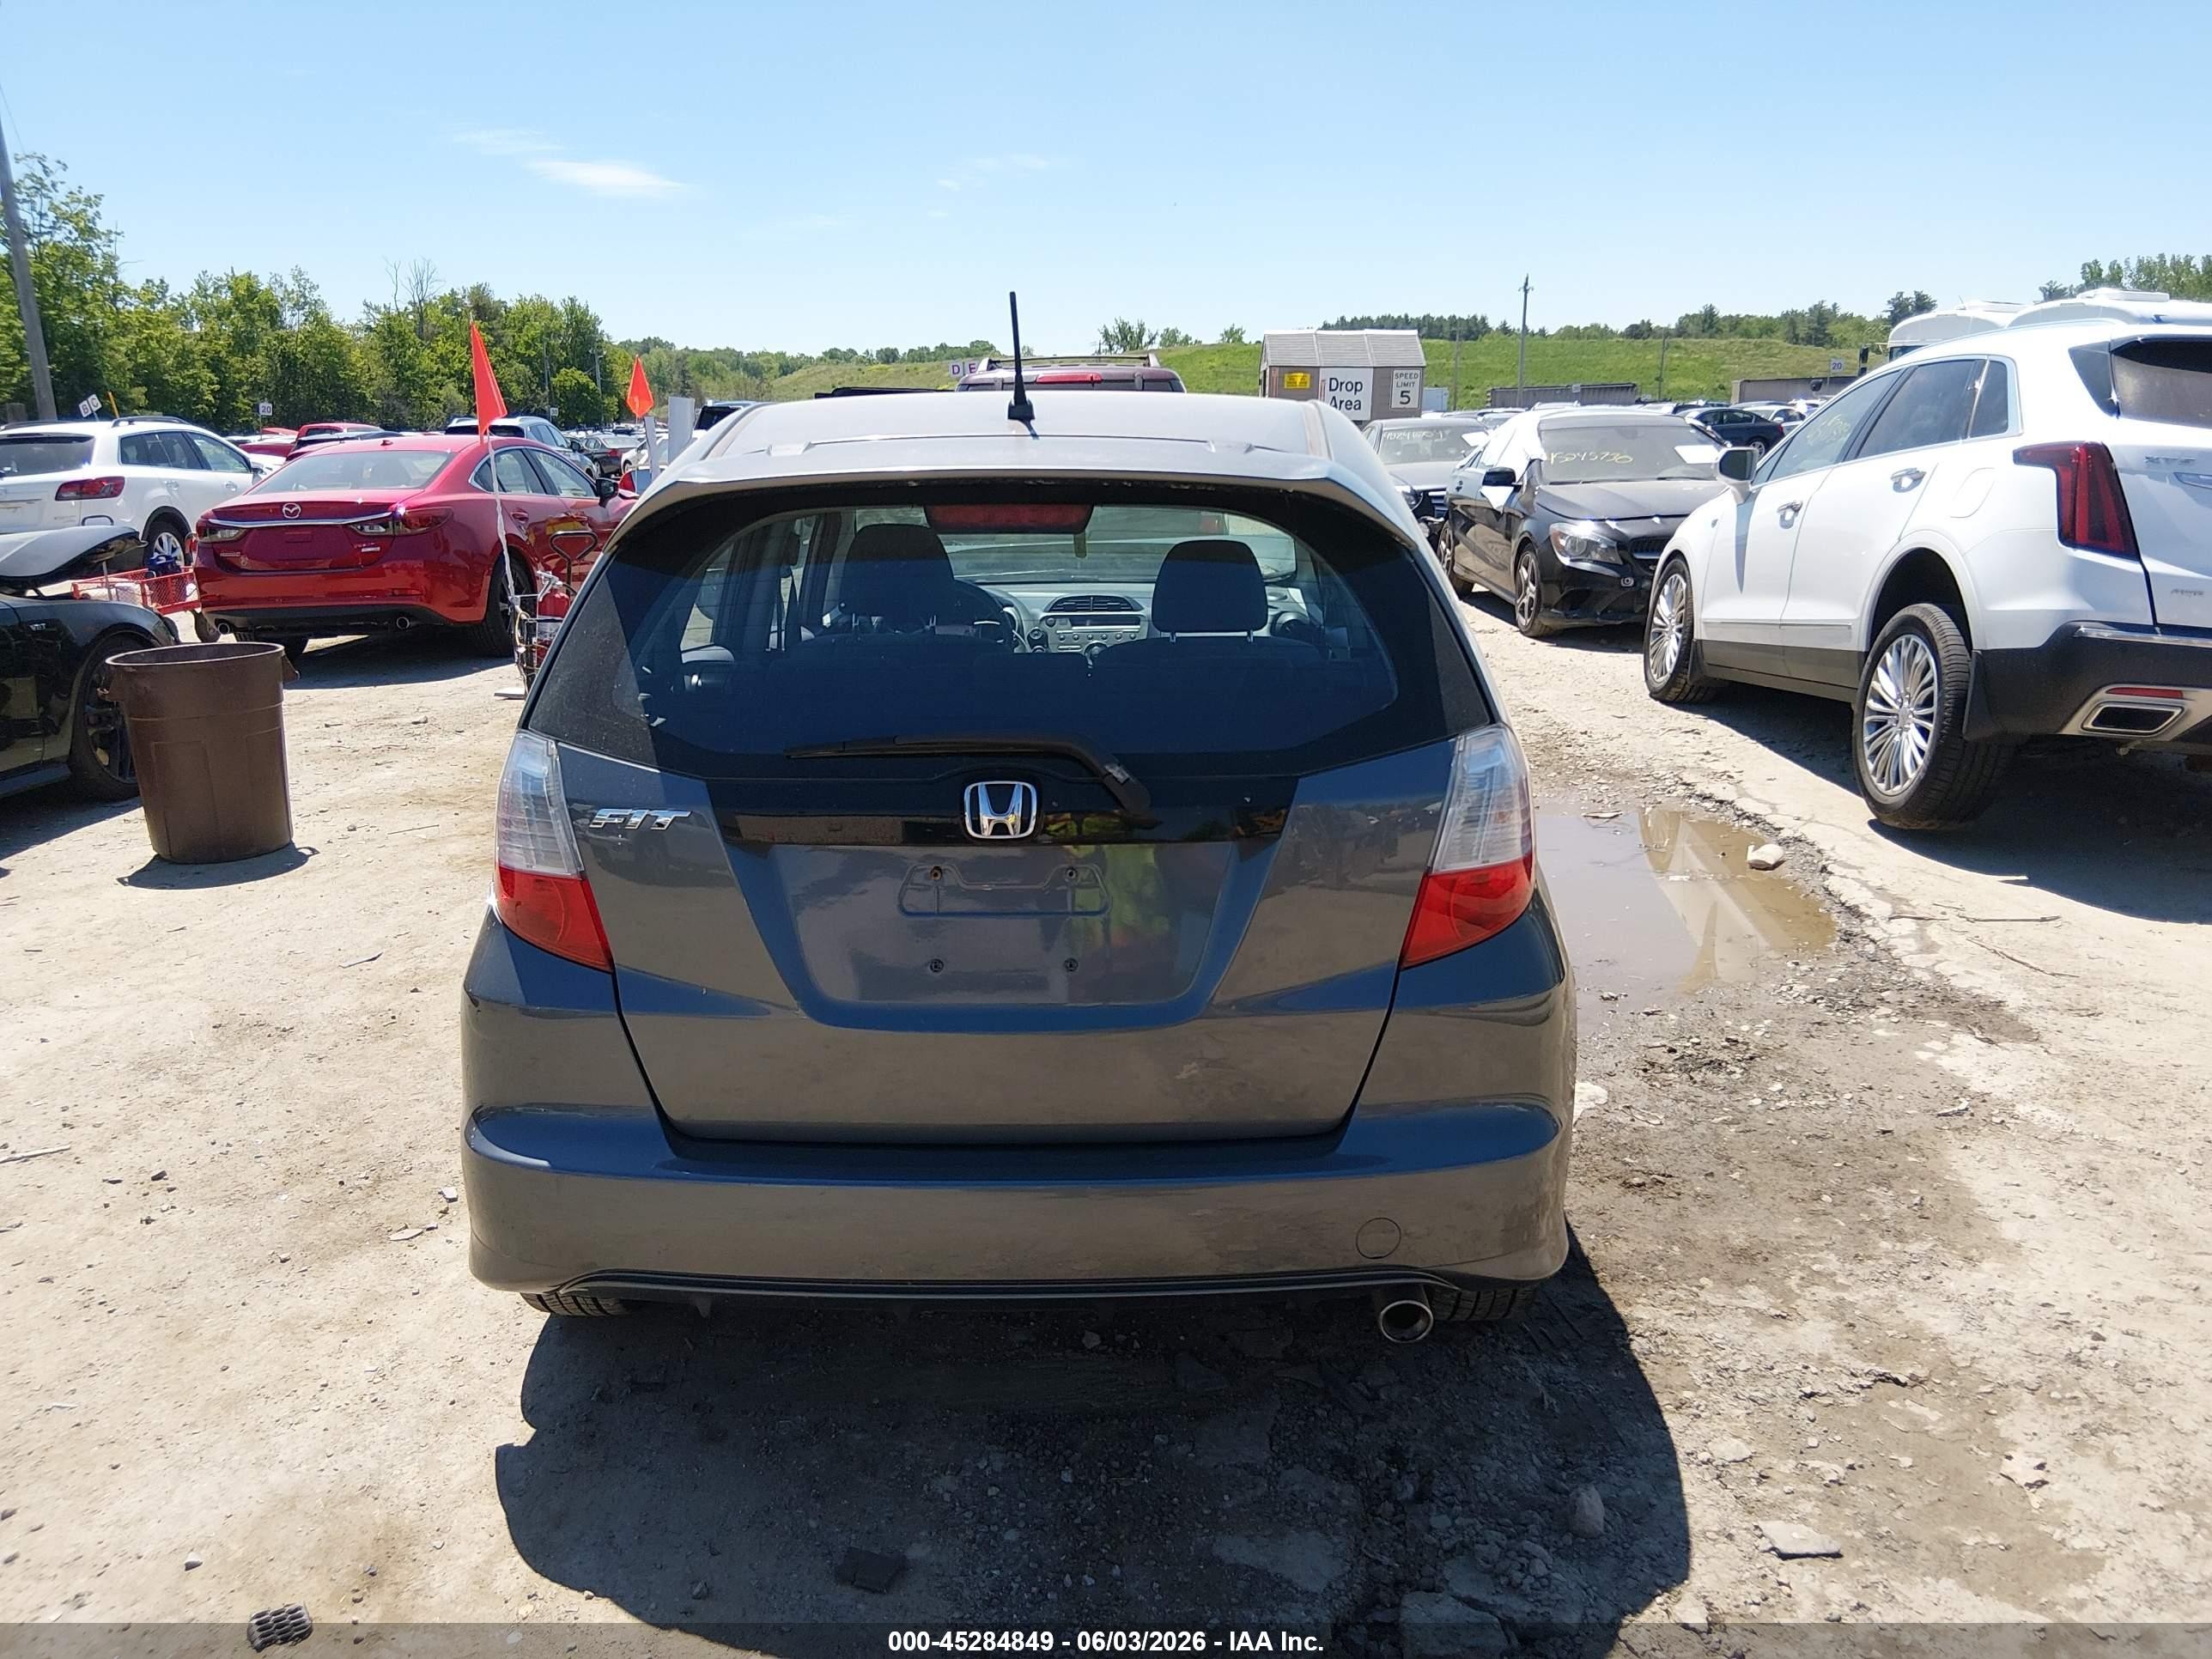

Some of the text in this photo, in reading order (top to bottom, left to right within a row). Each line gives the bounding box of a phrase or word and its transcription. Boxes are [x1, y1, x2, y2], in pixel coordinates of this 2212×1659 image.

[952, 362, 976, 374] D E
[1329, 377, 1363, 395] Drop
[1329, 395, 1362, 410] Area
[1400, 390, 1411, 404] 5
[82, 404, 89, 414] B
[589, 808, 692, 831] FIT
